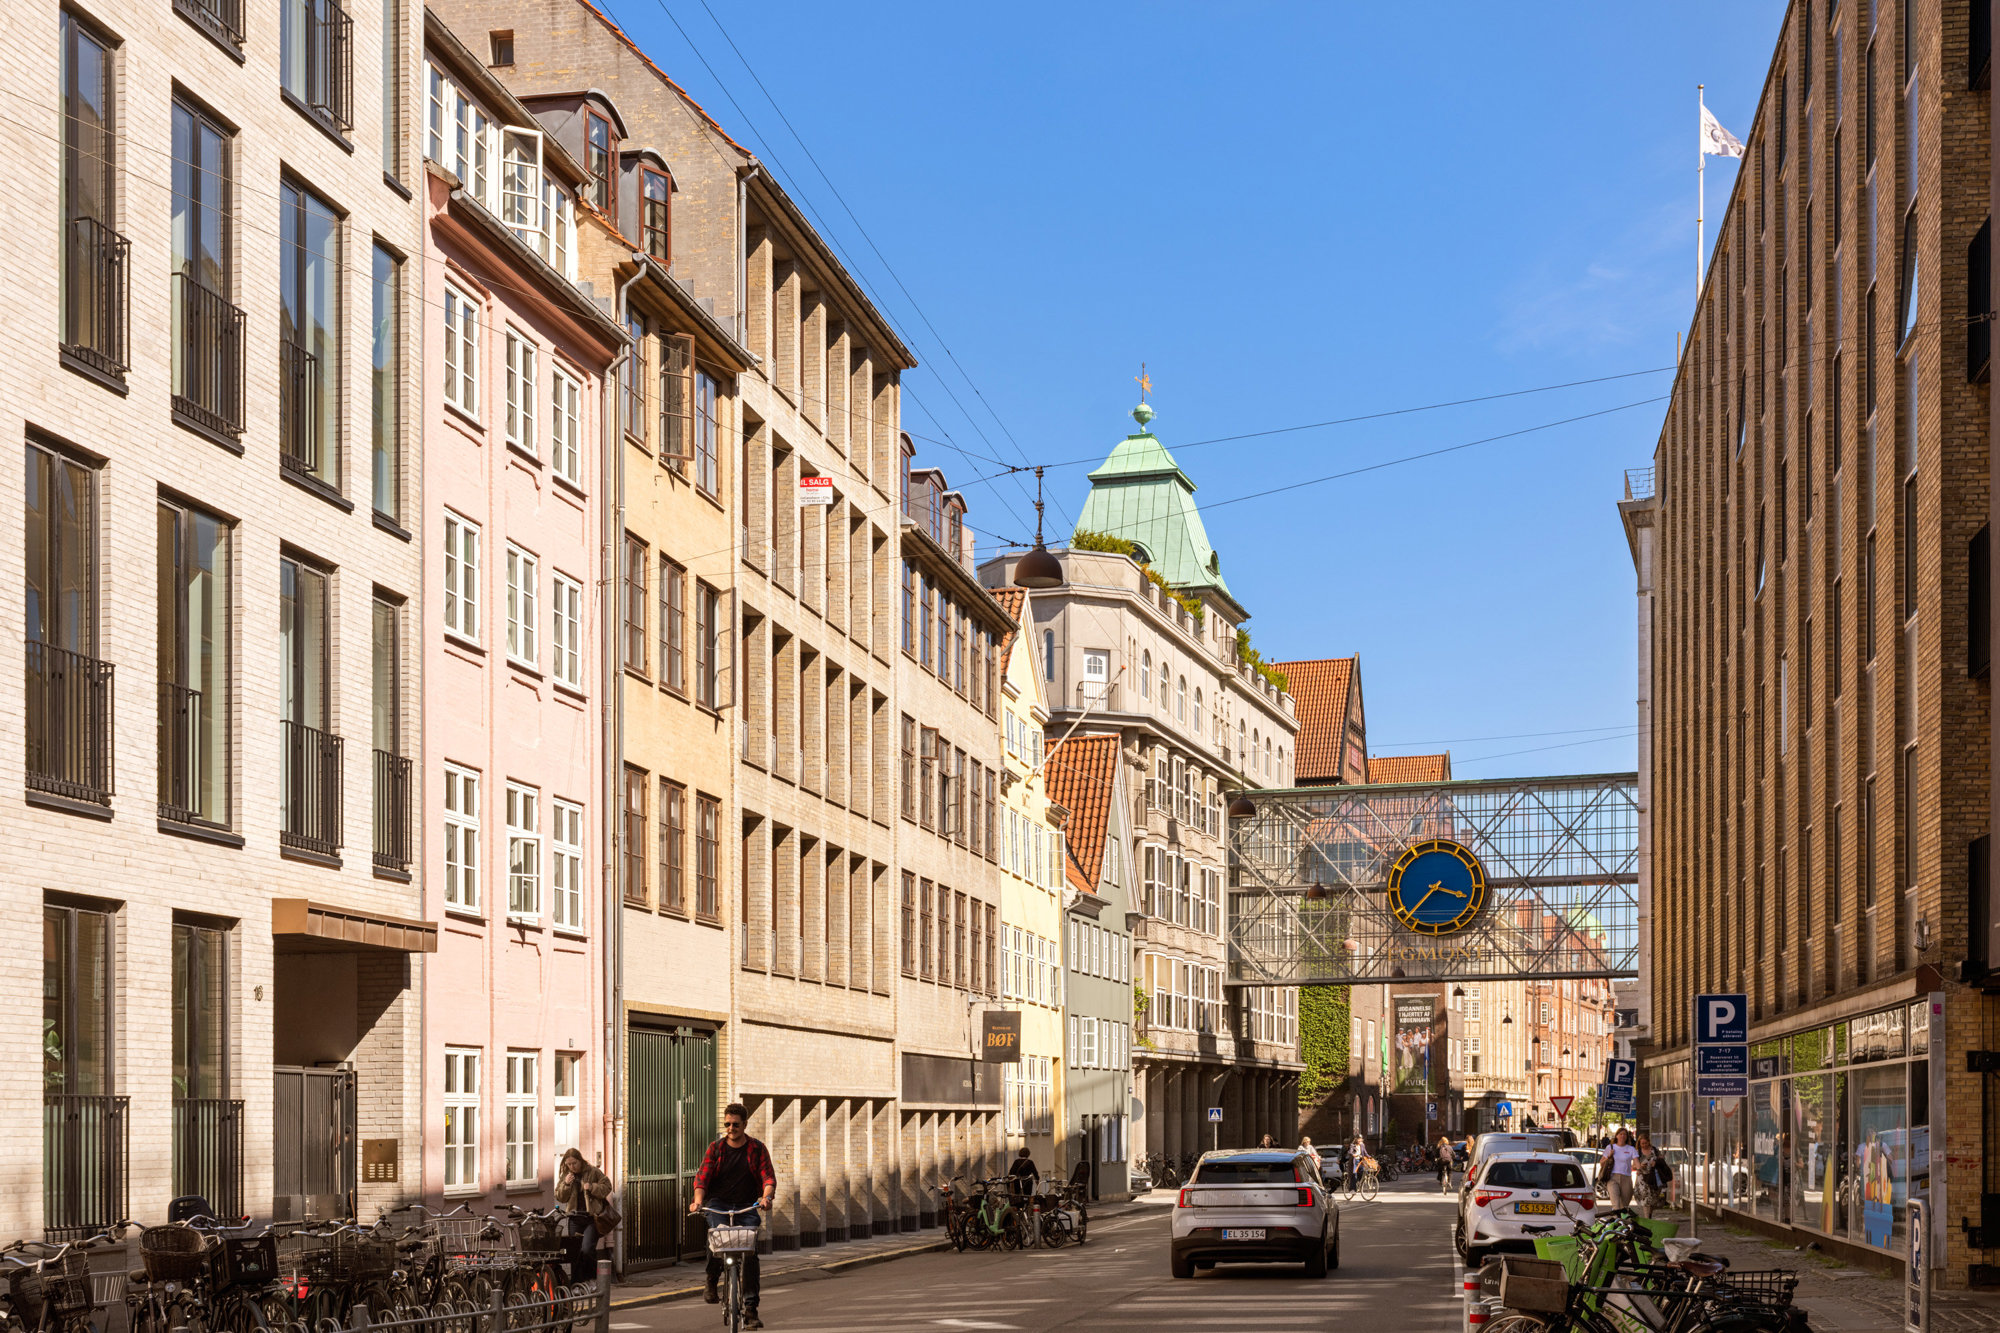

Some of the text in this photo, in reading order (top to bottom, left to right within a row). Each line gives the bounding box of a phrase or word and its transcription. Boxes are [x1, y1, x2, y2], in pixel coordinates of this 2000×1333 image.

[1388, 946, 1485, 961] EGMONT
[1709, 1001, 1735, 1037] P
[987, 1033, 1017, 1047] BØF
[1614, 1062, 1630, 1082] P
[1429, 1104, 1435, 1112] P
[1532, 1204, 1540, 1212] 15
[1540, 1204, 1555, 1213] 250
[1228, 1230, 1265, 1238] EL 35 154
